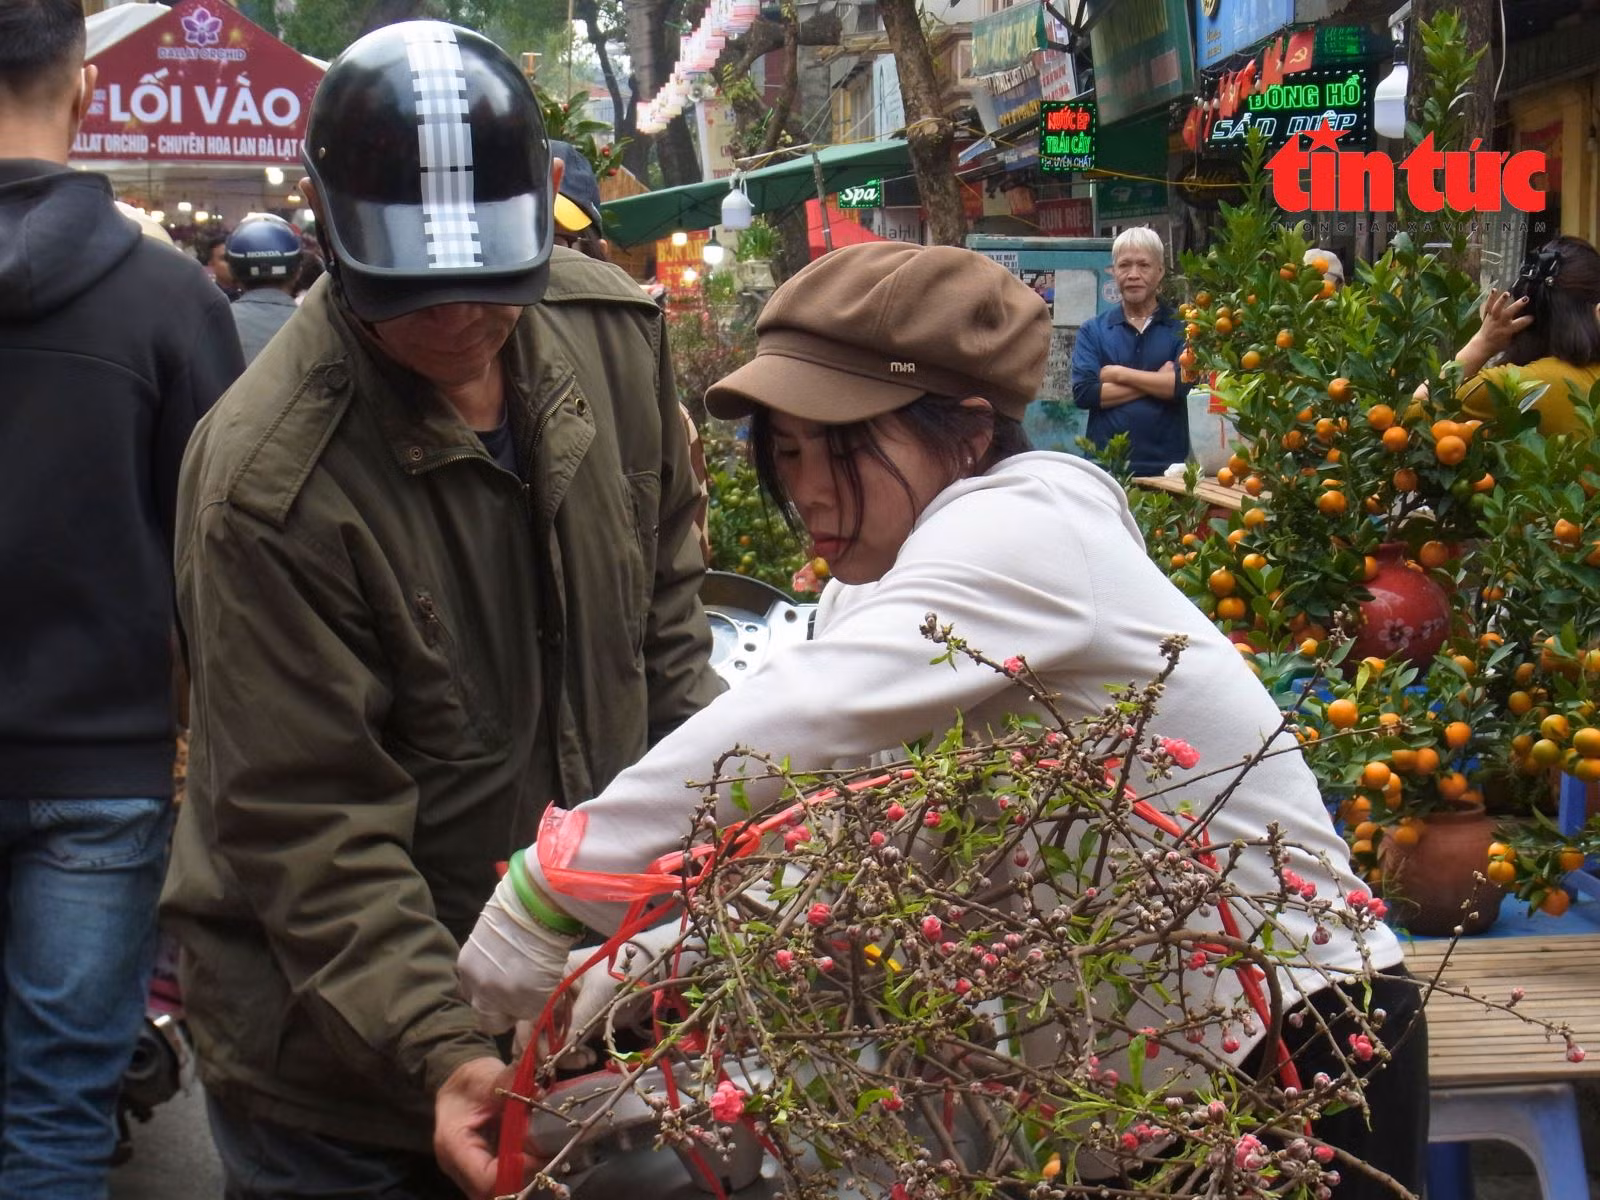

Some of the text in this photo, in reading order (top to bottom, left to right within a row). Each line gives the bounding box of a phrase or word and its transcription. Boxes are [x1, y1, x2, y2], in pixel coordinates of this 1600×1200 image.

[199, 48, 247, 60] ORCHID
[109, 68, 182, 123] LỐI
[195, 74, 300, 127] VÀO
[105, 133, 148, 153] ORCHID
[158, 132, 205, 155] CHUYÊN
[207, 136, 231, 155] HOA
[233, 136, 257, 156] LAN
[258, 133, 275, 157] ĐÀ
[277, 138, 298, 161] LẠT
[1046, 131, 1091, 153] TRÁI CÂY
[246, 250, 282, 258] HONDA
